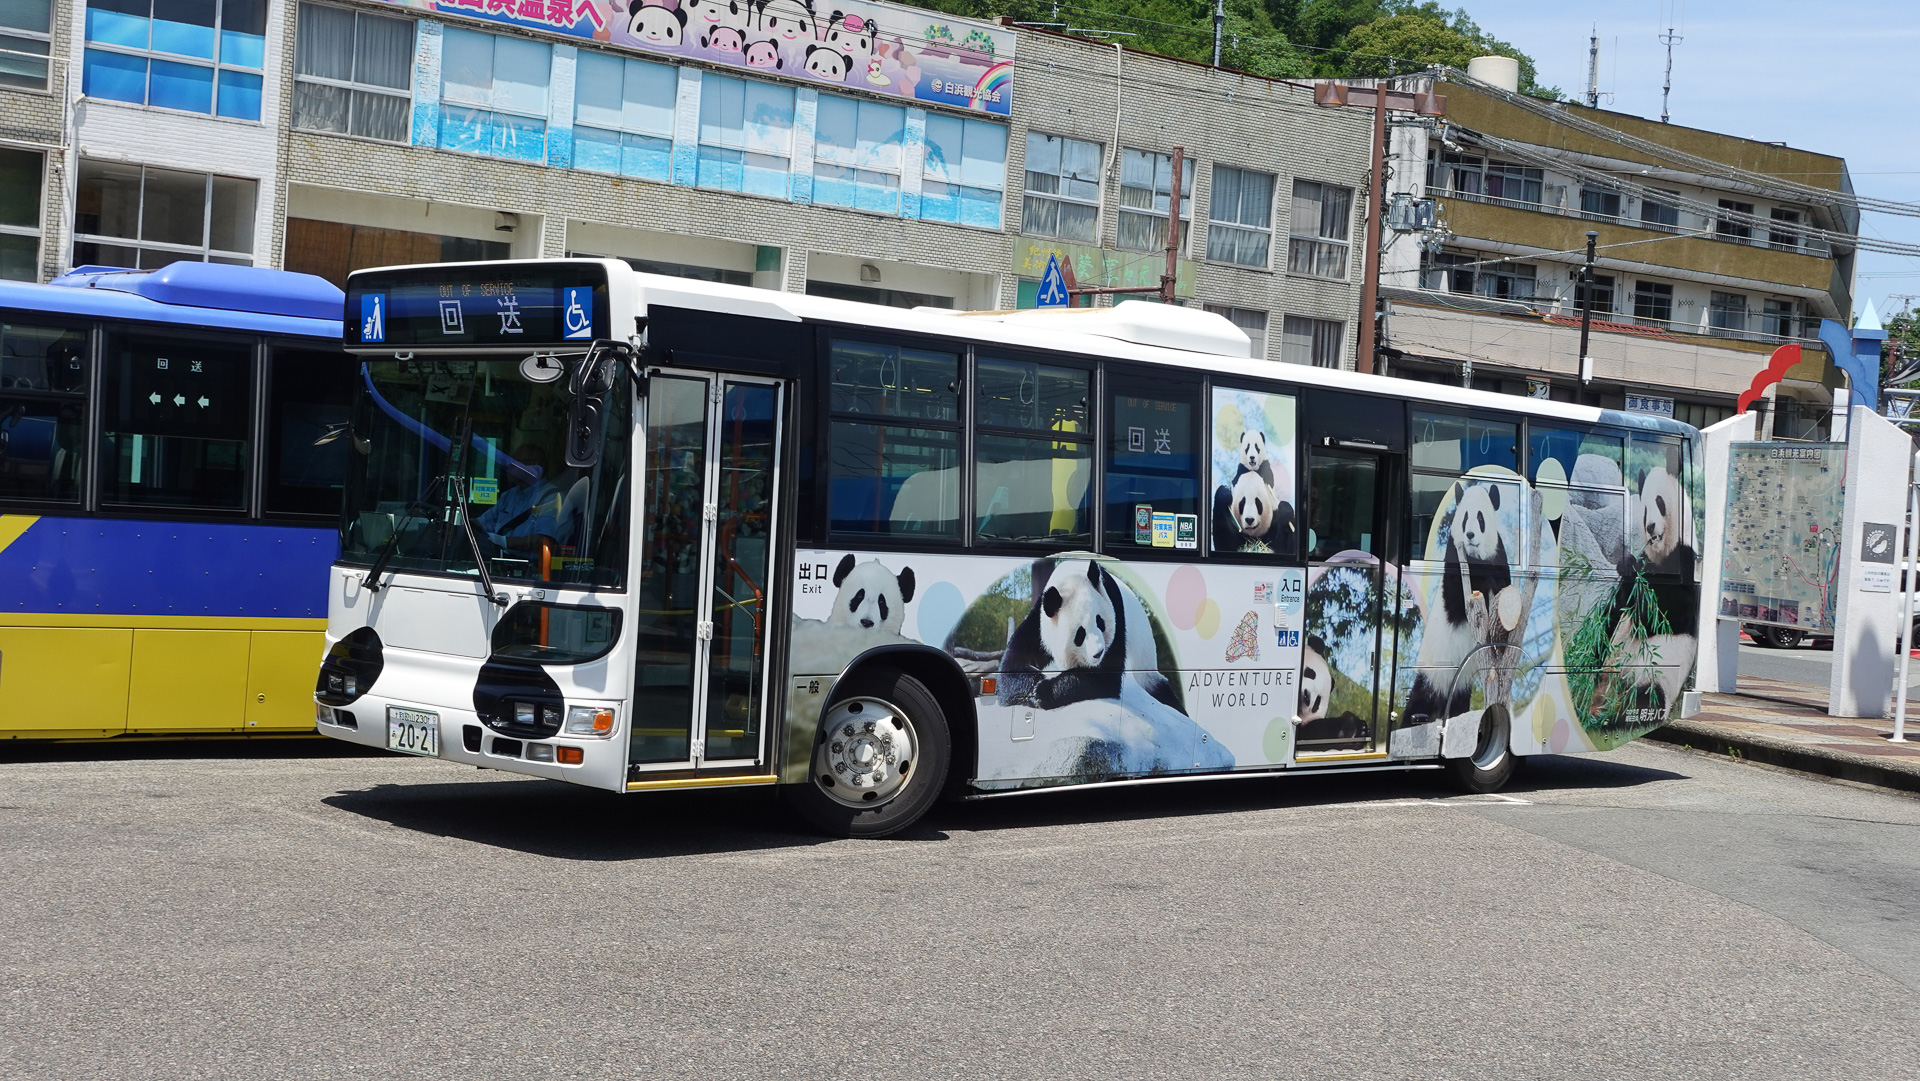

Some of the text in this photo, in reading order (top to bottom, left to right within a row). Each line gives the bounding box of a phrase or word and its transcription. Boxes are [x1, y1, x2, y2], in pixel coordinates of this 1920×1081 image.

[945, 82, 1001, 103] 白浜観光協会
[439, 282, 515, 298] OUT OF SERVICE
[439, 296, 524, 335] 回送
[1128, 398, 1176, 412] OUT OF SERVICE
[1629, 398, 1671, 413] 御食事処
[1128, 426, 1171, 455] 回送
[1771, 447, 1821, 459] 白浜観光案内図
[1180, 522, 1193, 531] NBA
[798, 563, 828, 581] 出口
[802, 584, 822, 594] Exit
[1281, 579, 1301, 592] 入口
[1281, 594, 1300, 602] Entrance
[797, 680, 820, 694] 一般
[1189, 672, 1293, 692] ADVENTURE
[1212, 693, 1269, 708] WORLD
[1640, 708, 1668, 721] 明光バス
